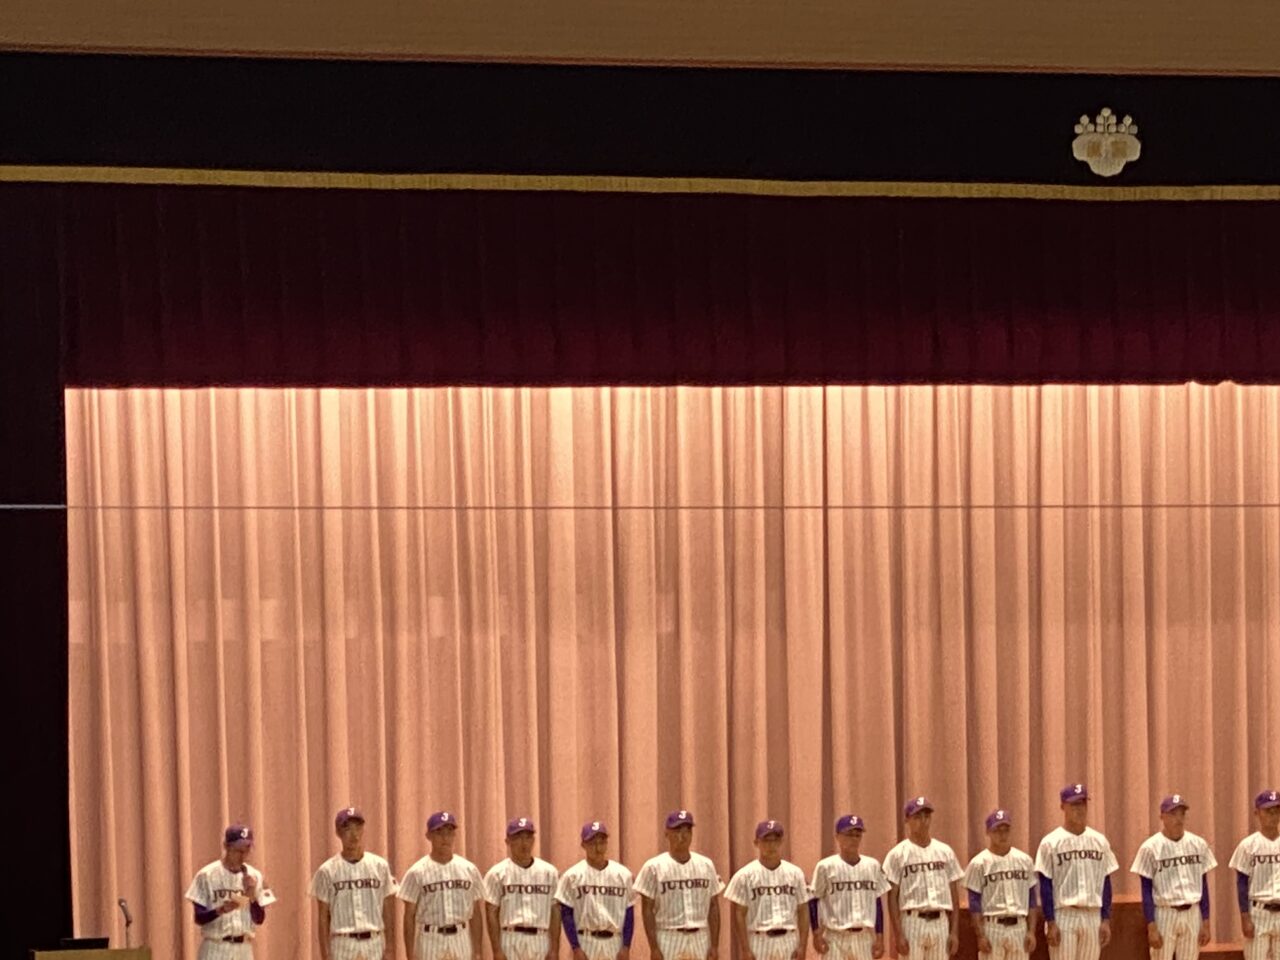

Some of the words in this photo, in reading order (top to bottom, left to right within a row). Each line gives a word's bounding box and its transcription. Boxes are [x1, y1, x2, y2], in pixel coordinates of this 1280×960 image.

[1056, 850, 1103, 865] JUTOKU
[333, 879, 380, 895] JUTOKU
[422, 880, 471, 893] JUTOKU
[501, 884, 550, 897] JUTOKU
[576, 885, 627, 898] JUTOKU
[661, 879, 710, 893] JUTOKU
